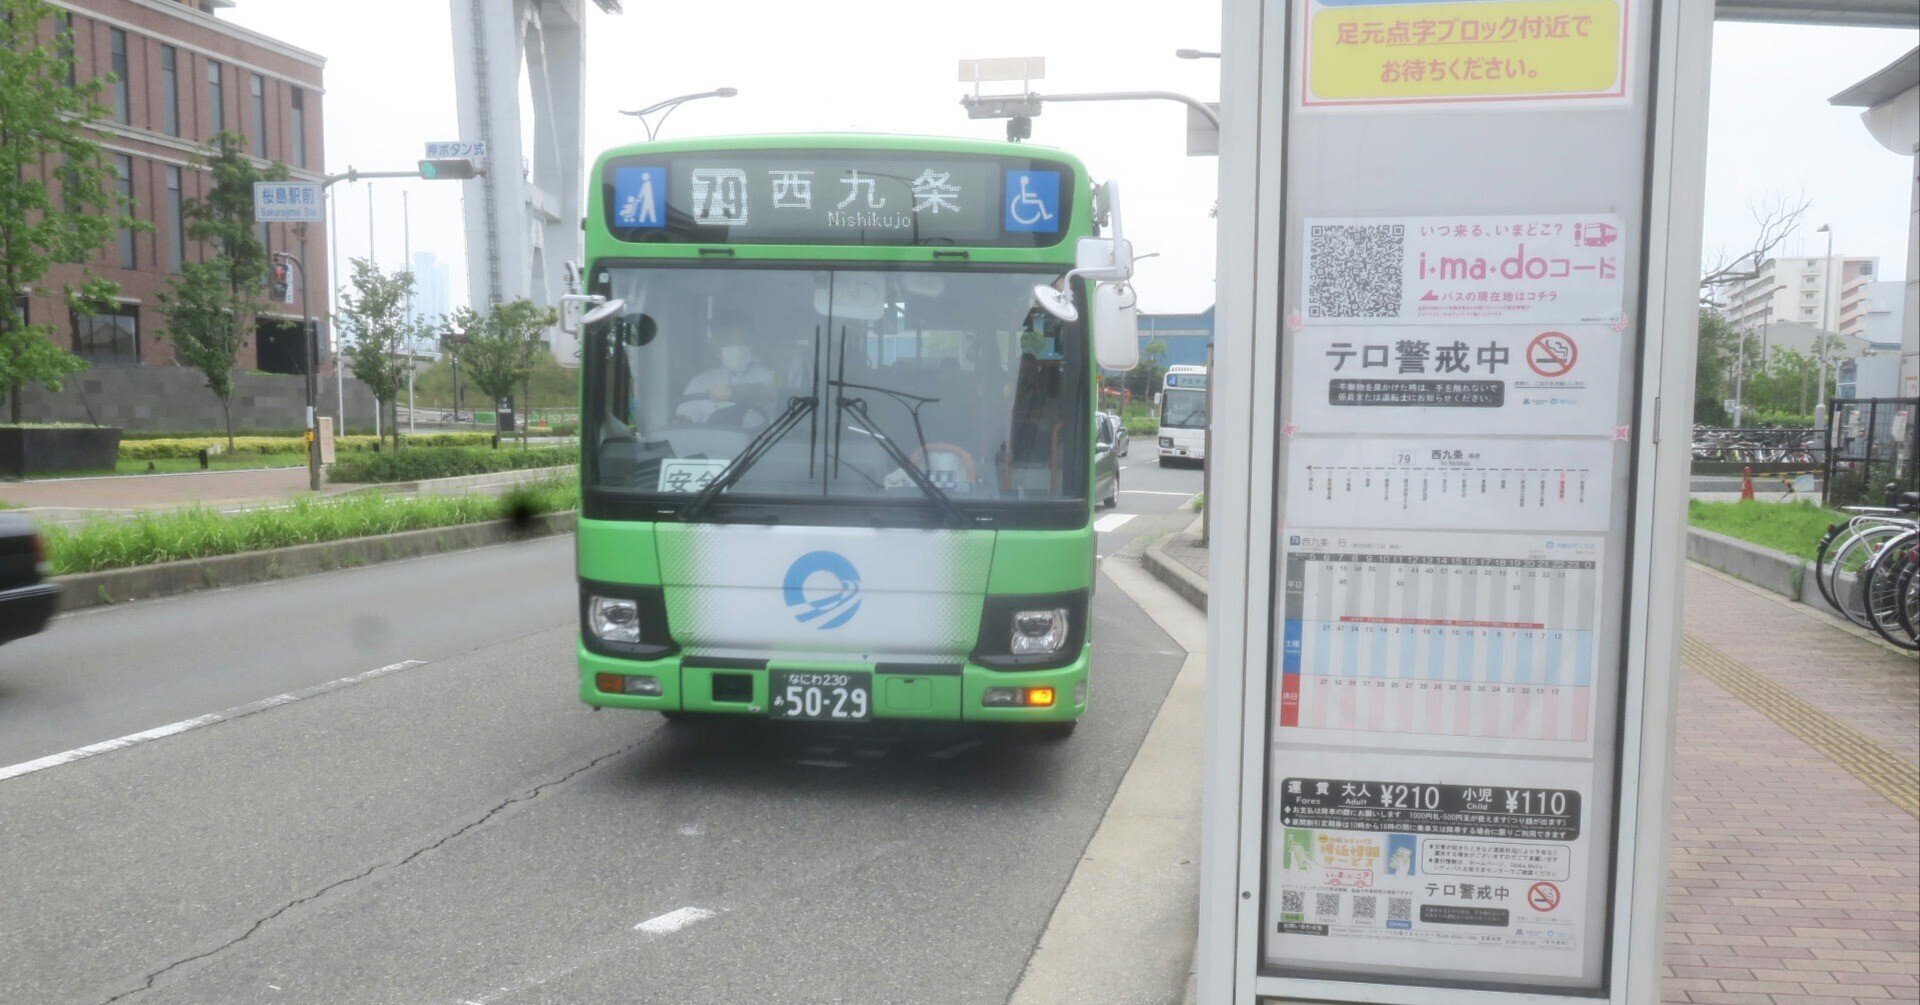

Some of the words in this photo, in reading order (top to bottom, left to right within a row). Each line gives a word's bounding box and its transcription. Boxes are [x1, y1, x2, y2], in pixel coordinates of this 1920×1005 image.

[1335, 15, 1593, 46] 足元点字ブロック付近で
[1380, 57, 1539, 84] お待ちください。
[426, 144, 485, 157] 押ボタン式
[262, 187, 315, 205] 桜島駅前
[696, 174, 742, 219] 79
[768, 168, 961, 213] 西九条
[260, 207, 301, 217] Sakurajima
[828, 212, 912, 230] Nishikujo
[1441, 291, 1559, 303] バスの現在地はコチラ
[1325, 339, 1510, 375] テロ警戒中
[1397, 454, 1411, 464] 79
[1431, 449, 1463, 460] 西九条
[788, 673, 848, 686] なにわ230
[773, 695, 784, 707] あ
[786, 685, 867, 718] 50-29
[1341, 783, 1371, 798] 大人
[1380, 784, 1440, 810] ¥210
[1461, 788, 1493, 803] 小児
[1505, 790, 1566, 816] ¥110
[1345, 798, 1368, 806] Adult
[1466, 803, 1488, 811] Child
[1425, 883, 1510, 902] テロ警戒中
